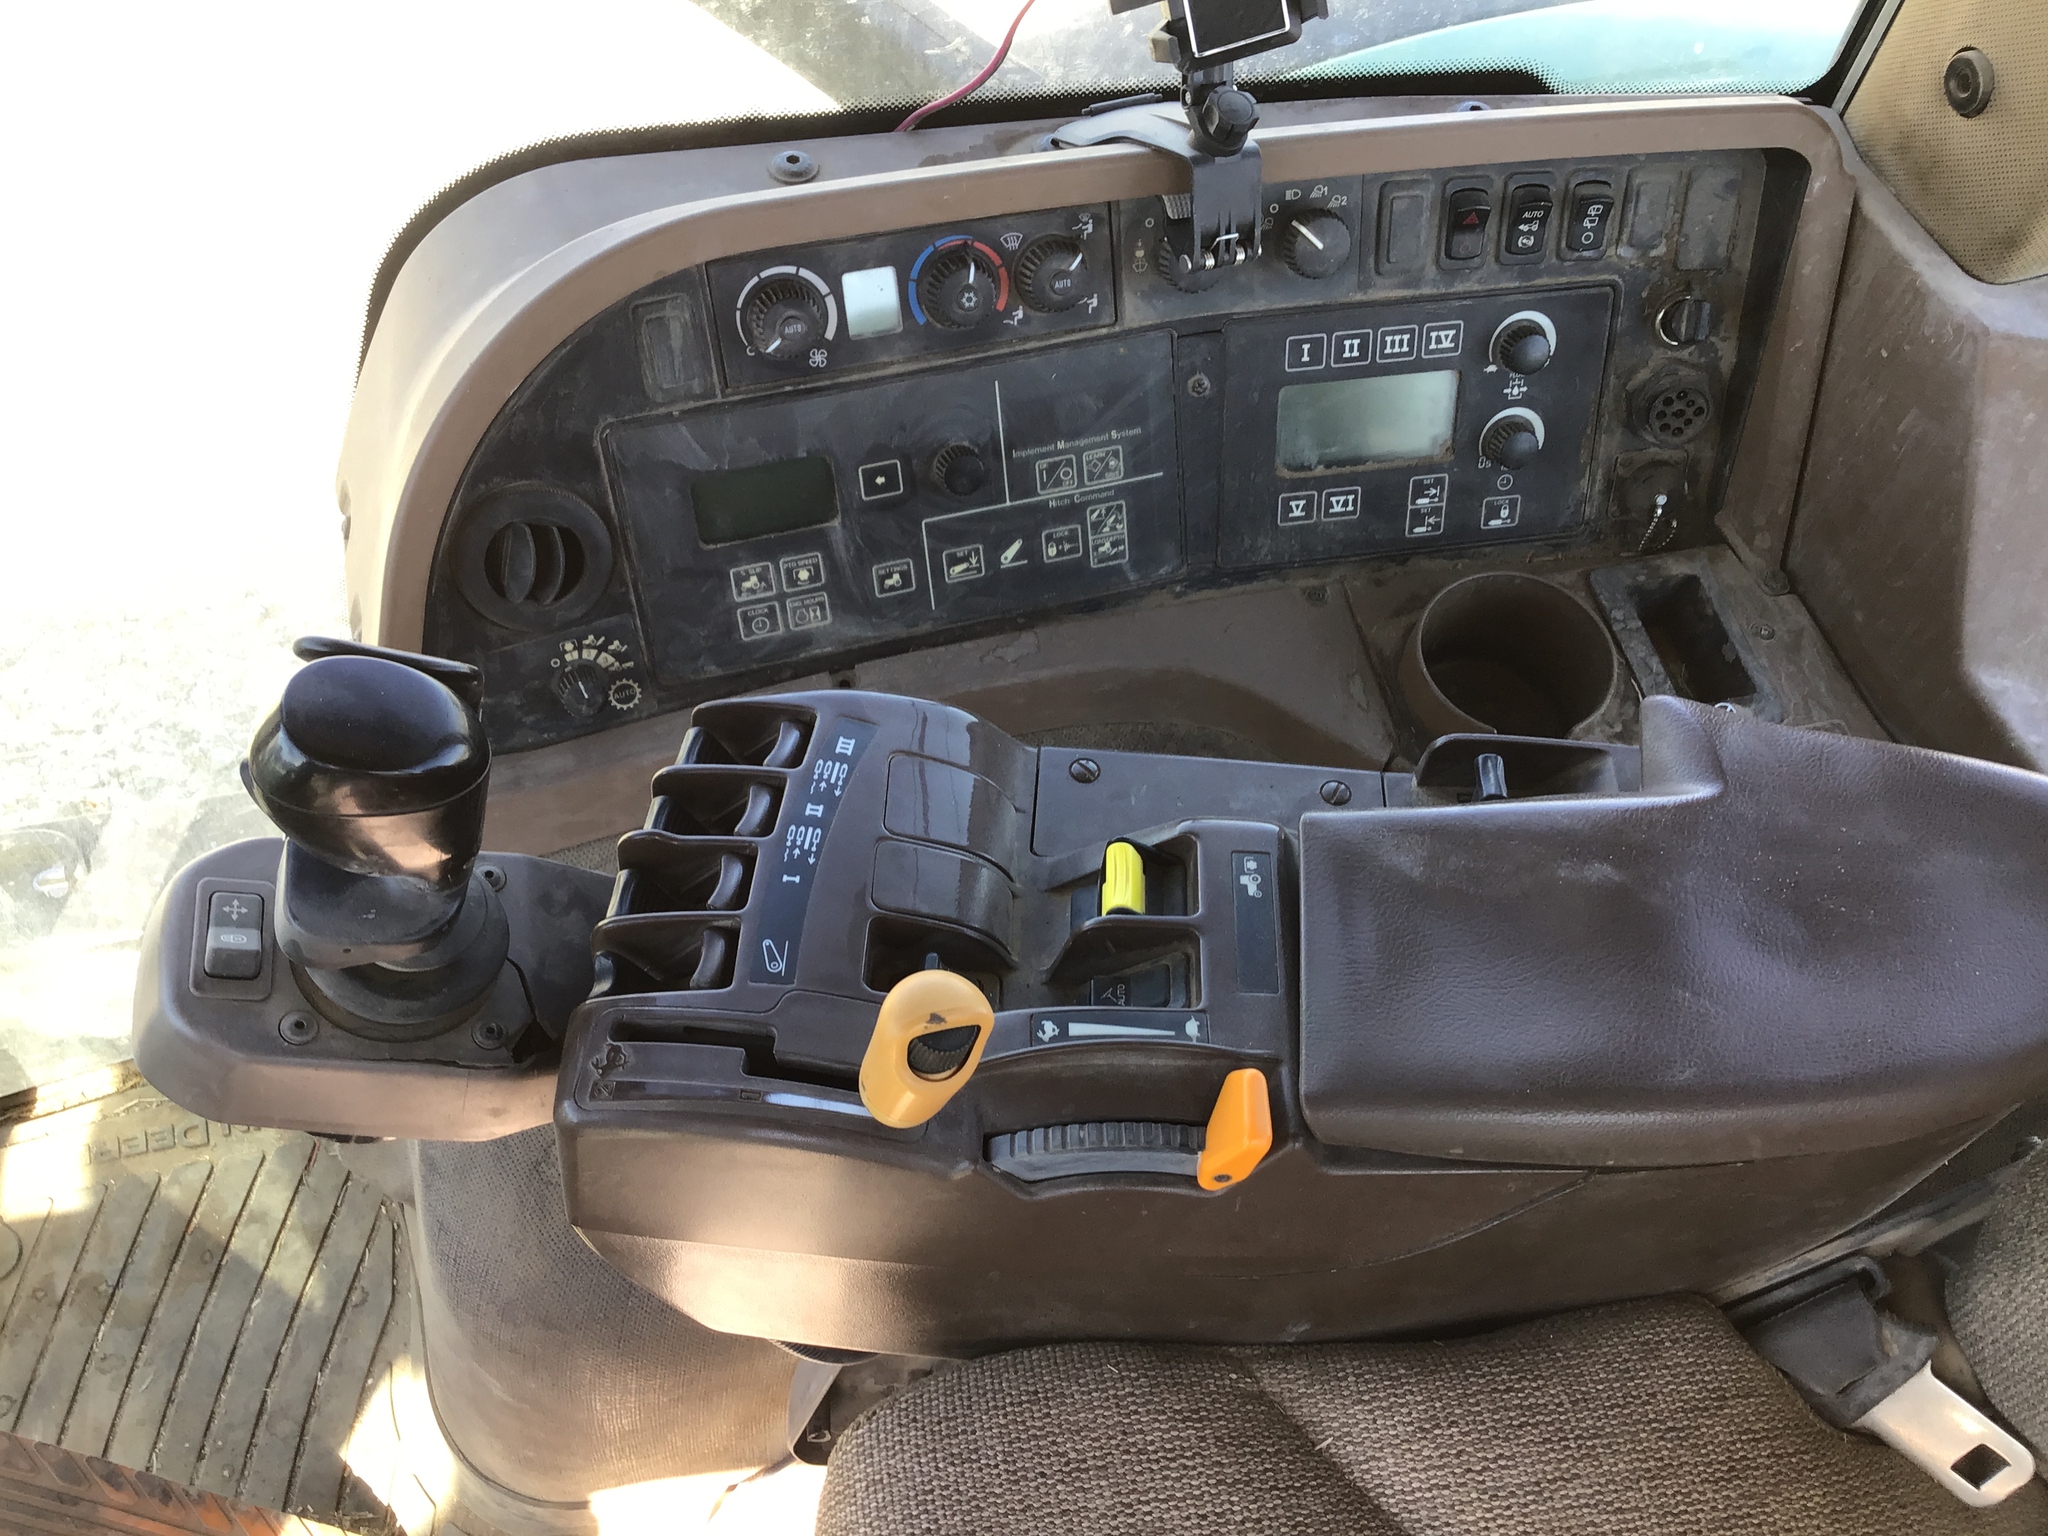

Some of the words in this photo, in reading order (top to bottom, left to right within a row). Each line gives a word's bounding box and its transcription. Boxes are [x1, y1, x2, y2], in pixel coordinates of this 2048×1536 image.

[1523, 211, 1544, 219] AUTO
[1054, 278, 1073, 290] AUTO
[784, 323, 802, 335] AUTO
[1342, 338, 1361, 358] II
[1384, 333, 1410, 354] III
[1428, 329, 1457, 350] IV
[1301, 343, 1311, 362] I
[1012, 443, 1055, 458] Implement
[1056, 433, 1109, 450] Management
[1111, 426, 1142, 441] System
[1049, 498, 1071, 509] Hitch
[1073, 489, 1115, 504] Command
[1289, 499, 1307, 518] V
[1329, 494, 1355, 514] VI
[797, 557, 818, 567] SPEED
[614, 688, 637, 700] AUTO
